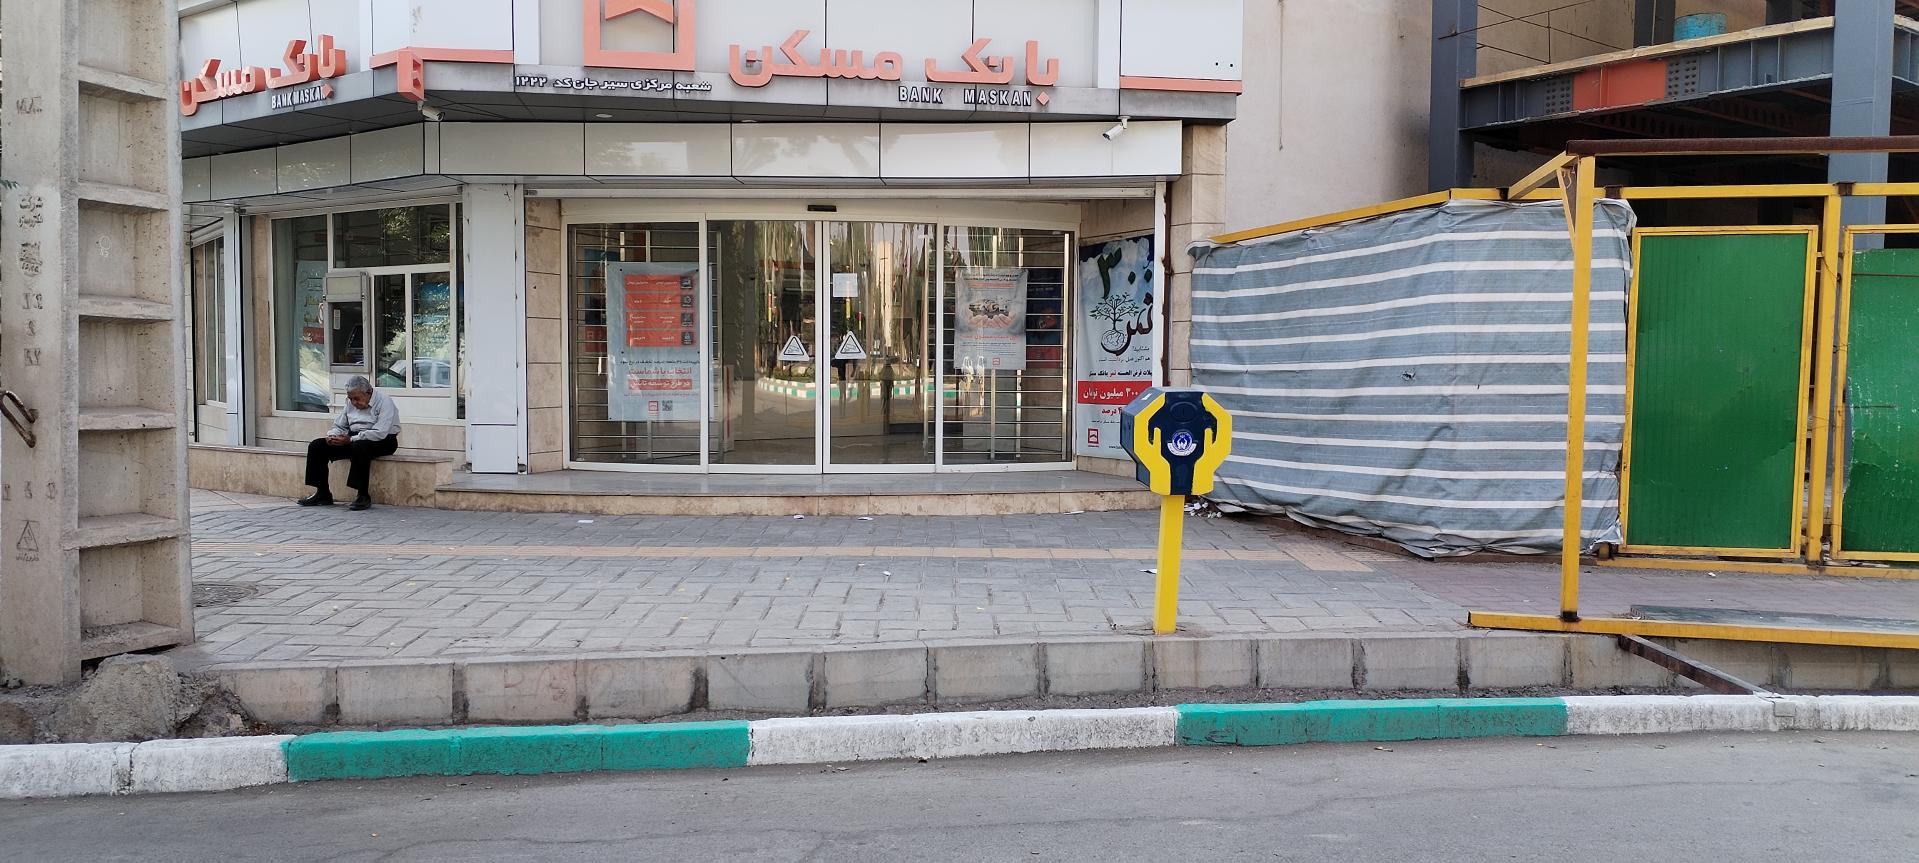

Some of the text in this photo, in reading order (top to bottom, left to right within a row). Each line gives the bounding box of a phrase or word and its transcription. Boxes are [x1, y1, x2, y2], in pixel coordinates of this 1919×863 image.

[728, 29, 1059, 87] بانک مسکن
[179, 34, 346, 116] بانک مسکن
[552, 77, 572, 89] کد
[630, 78, 674, 91] مرکزی
[674, 79, 712, 92] شعبه
[271, 92, 293, 110] BANK
[898, 86, 1032, 107] BANK MASKAN
[1083, 387, 1099, 400] تومان
[1099, 387, 1124, 400] میلیون
[1101, 407, 1118, 417] درصد
